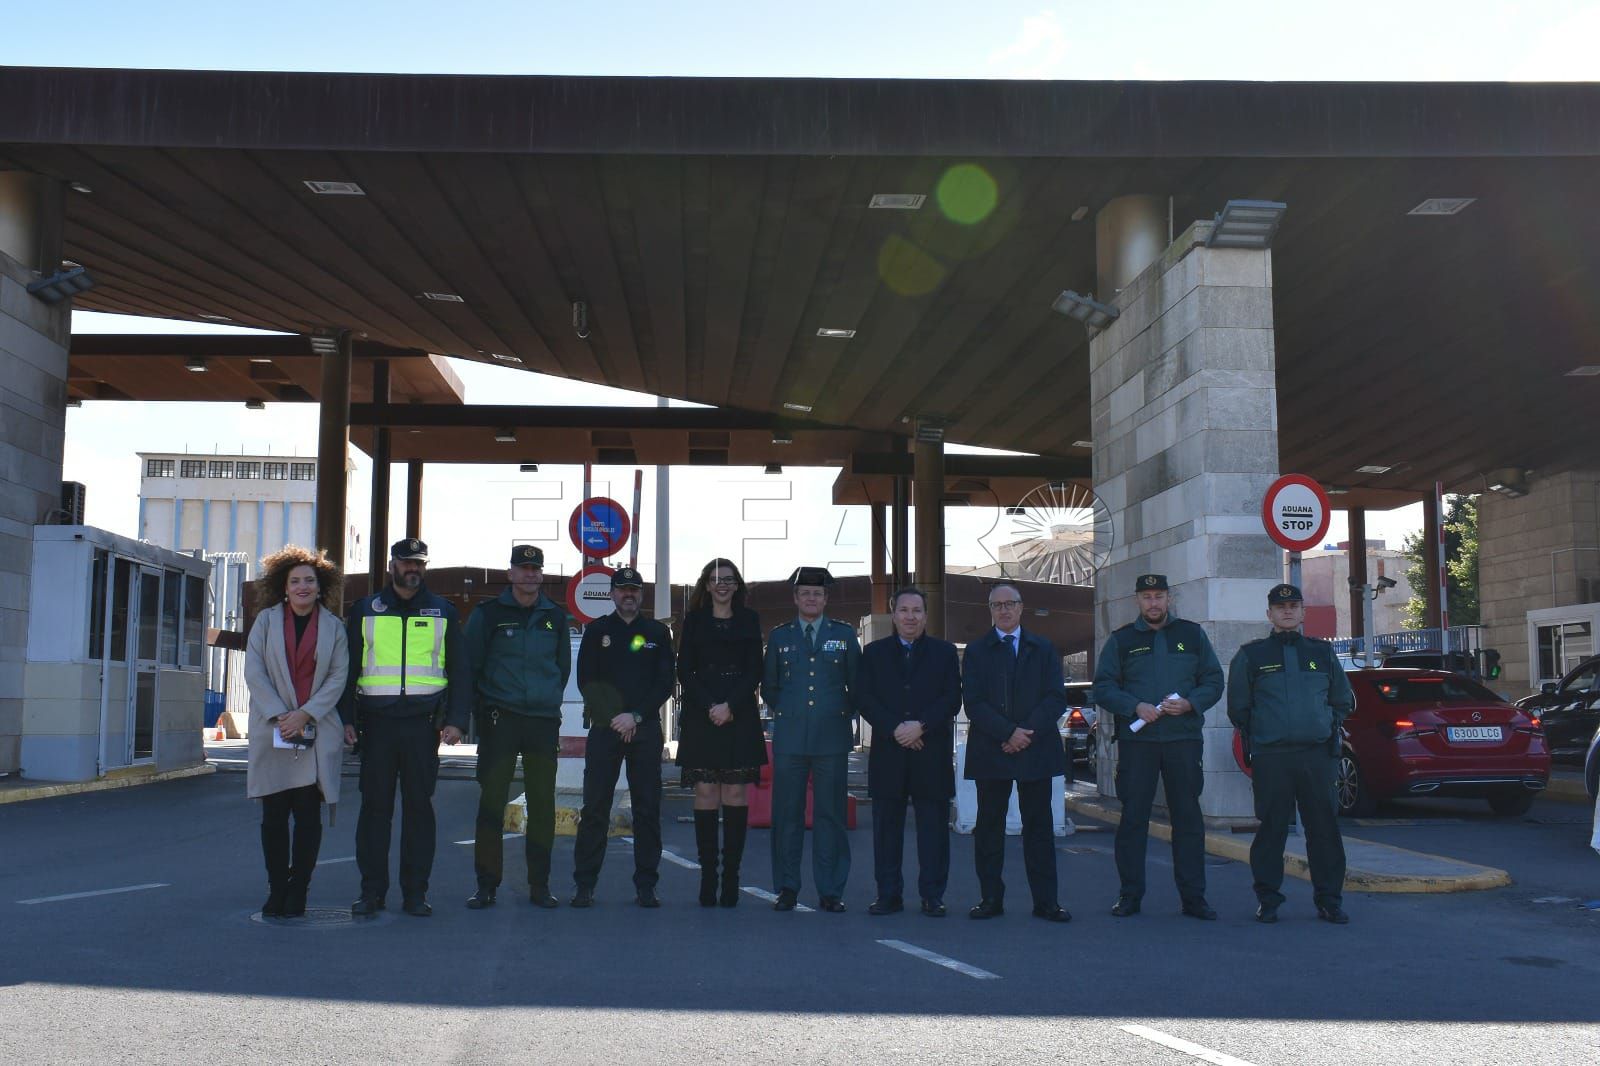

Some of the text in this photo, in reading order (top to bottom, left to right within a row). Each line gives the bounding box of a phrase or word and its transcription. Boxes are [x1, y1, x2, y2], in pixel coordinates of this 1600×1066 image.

[1282, 505, 1313, 513] ADUANA
[1282, 520, 1313, 531] STOP
[1454, 727, 1500, 738] 6300 LCG
